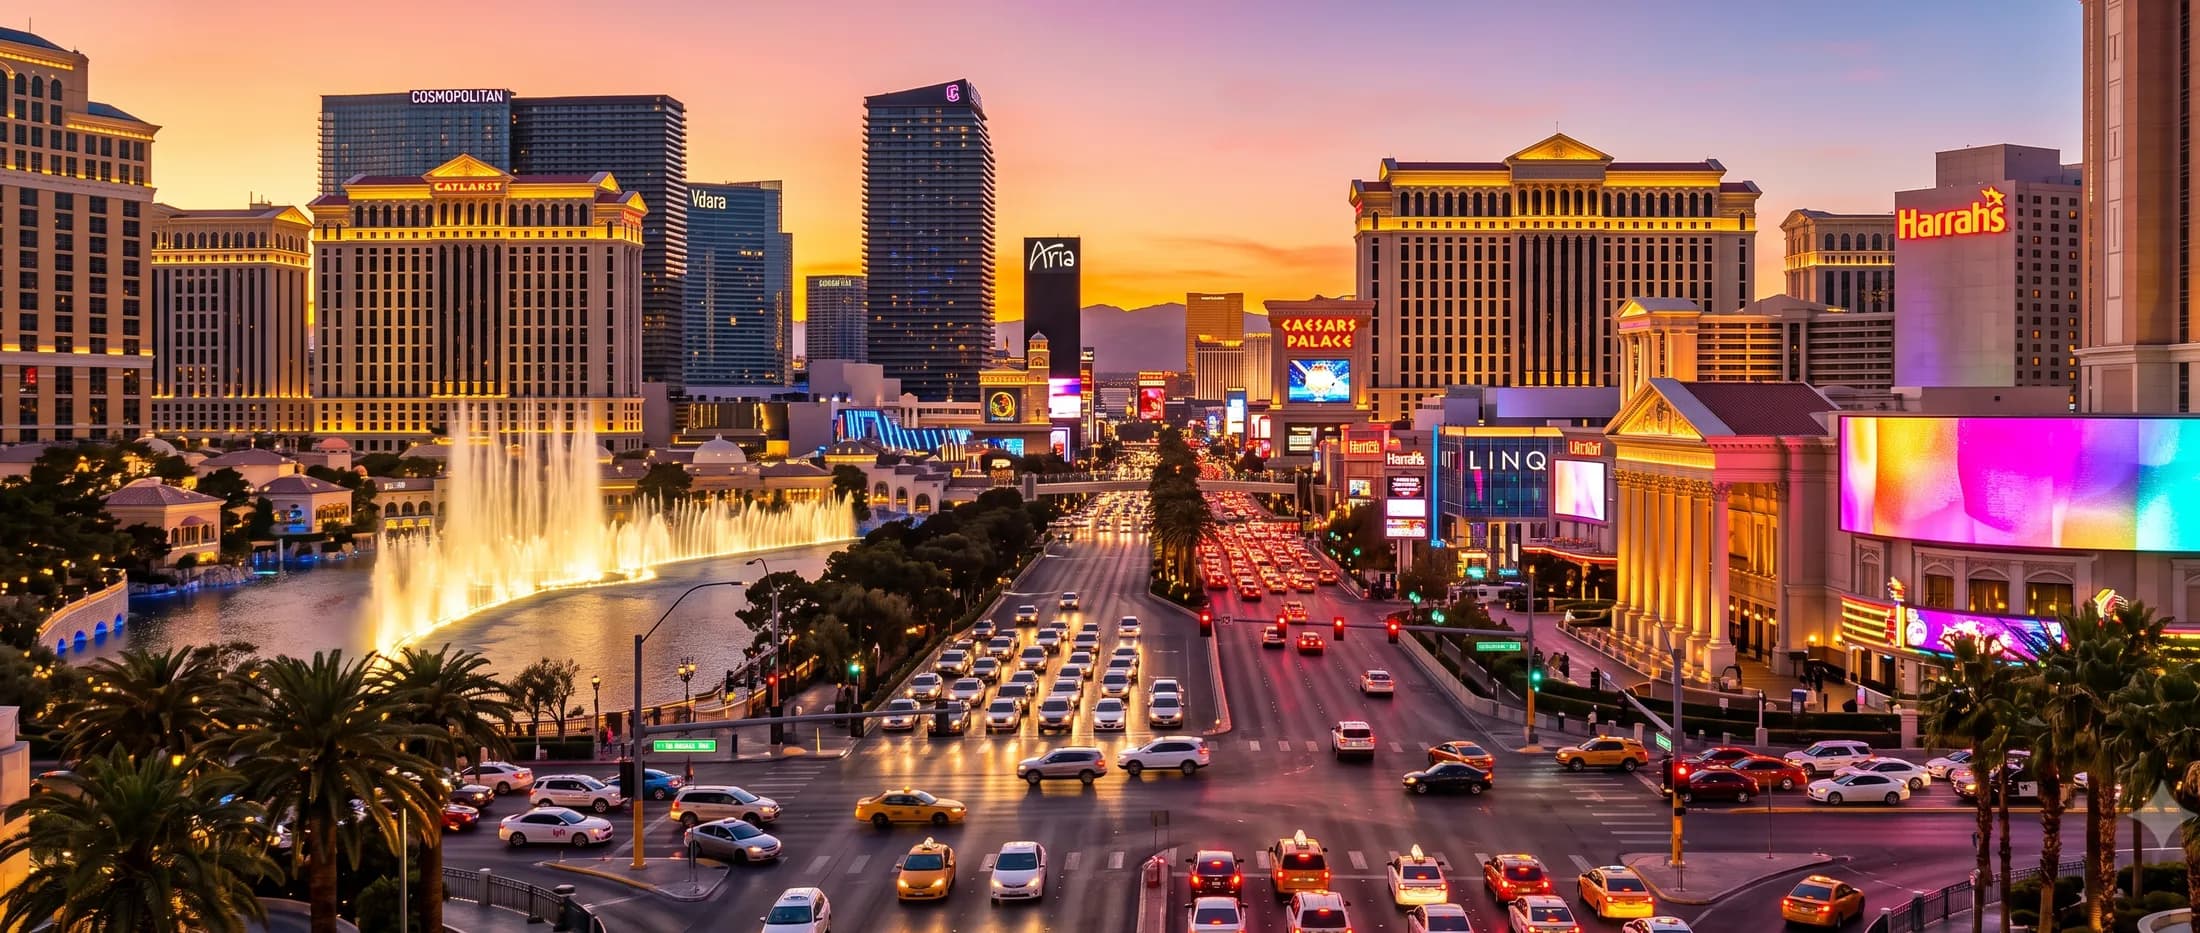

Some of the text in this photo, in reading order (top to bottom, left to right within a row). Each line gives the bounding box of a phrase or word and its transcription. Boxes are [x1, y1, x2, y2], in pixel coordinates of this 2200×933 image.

[411, 89, 503, 104] COSMOPOLITAN
[434, 182, 502, 193] CATLARST
[691, 189, 726, 210] Vdara
[1029, 241, 1075, 271] Aria
[1281, 318, 1357, 332] CAESARS
[1287, 334, 1352, 348] PALACE
[1469, 450, 1546, 471] LINQ
